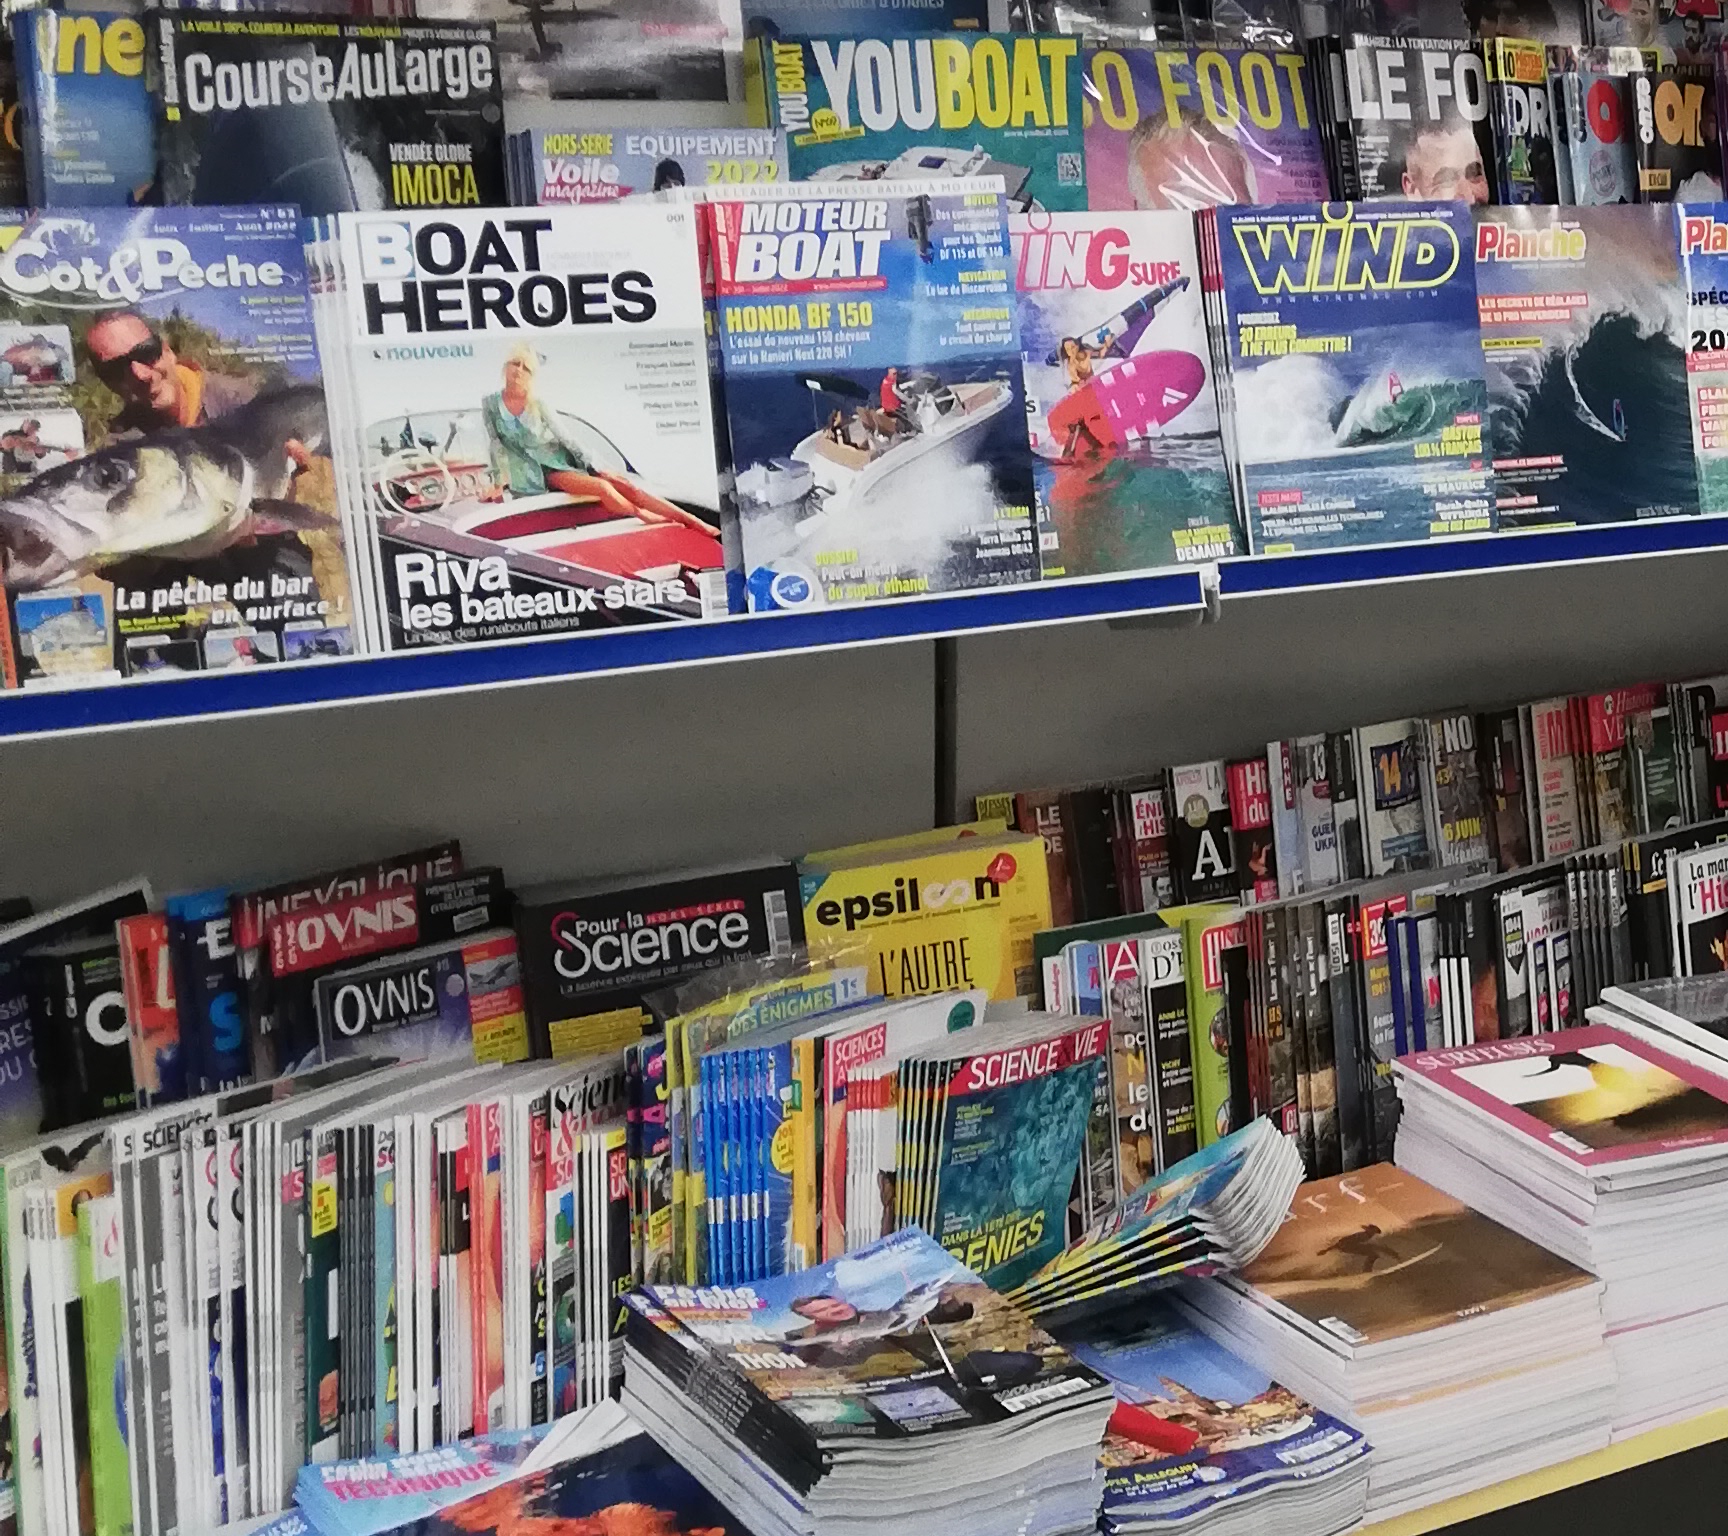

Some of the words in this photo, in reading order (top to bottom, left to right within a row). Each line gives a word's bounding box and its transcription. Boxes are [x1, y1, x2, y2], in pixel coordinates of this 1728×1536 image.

[1155, 52, 1310, 130] FOOT
[626, 133, 777, 158] EQUIPEMENT
[392, 164, 480, 205] IMOCA
[544, 182, 620, 201] magazine
[667, 214, 684, 223] 001
[741, 201, 888, 234] MOTEUR
[359, 220, 552, 279] BOAT
[735, 230, 890, 282] BOAT
[1476, 221, 1586, 262] Planche
[364, 272, 657, 335] HEROES
[726, 304, 800, 334] HONDA
[807, 303, 831, 328] BF
[838, 302, 873, 328] 150
[387, 343, 473, 361] nouveau
[395, 551, 511, 598] Riva
[211, 605, 240, 627] en
[245, 598, 330, 622] surface
[401, 597, 453, 630] les
[460, 588, 598, 624] bateaux
[604, 579, 687, 609] stars
[1690, 862, 1705, 880] La
[297, 894, 418, 954] OVNIS
[575, 917, 622, 938] Pour
[627, 910, 644, 927] la
[553, 911, 749, 979] Science
[879, 937, 973, 996] L'AUTRE
[333, 967, 436, 1036] OVNIS
[835, 1023, 885, 1064] SCIENCES
[968, 1039, 1061, 1091] SCIENCE
[1074, 1026, 1102, 1057] VIE
[729, 1352, 806, 1370] THON
[327, 1461, 498, 1502] TECHNIQUE
